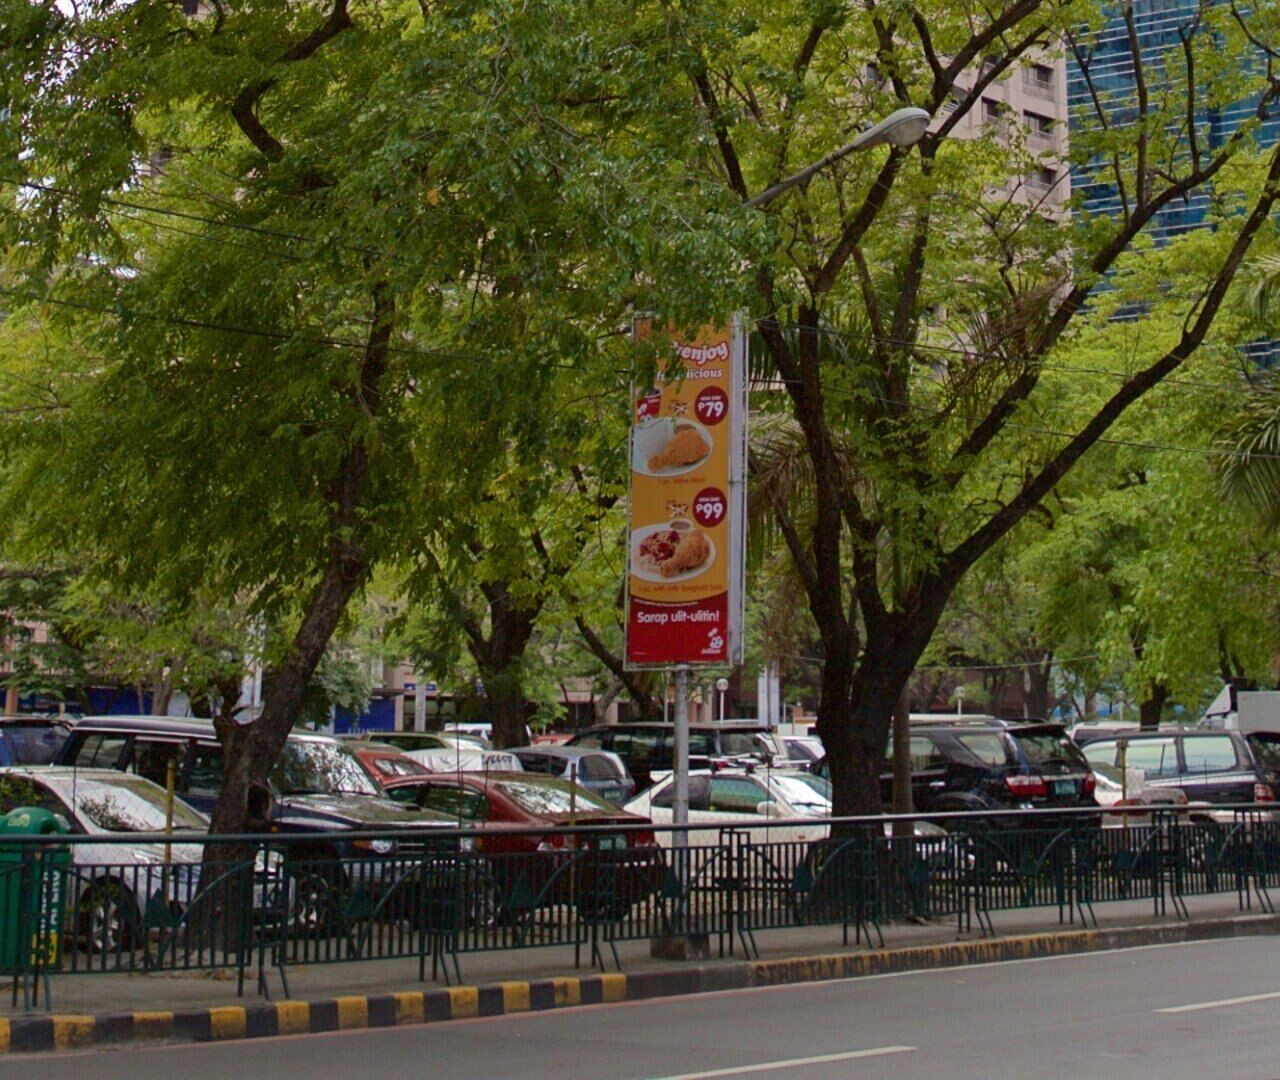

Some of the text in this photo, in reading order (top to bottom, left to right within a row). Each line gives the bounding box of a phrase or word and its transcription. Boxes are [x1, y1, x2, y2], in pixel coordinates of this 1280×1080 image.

[637, 610, 720, 626] Sarap ulit-ulitin!
[753, 932, 1089, 987] STRICTLY NO PARKING NO WAITING ANYTIME
